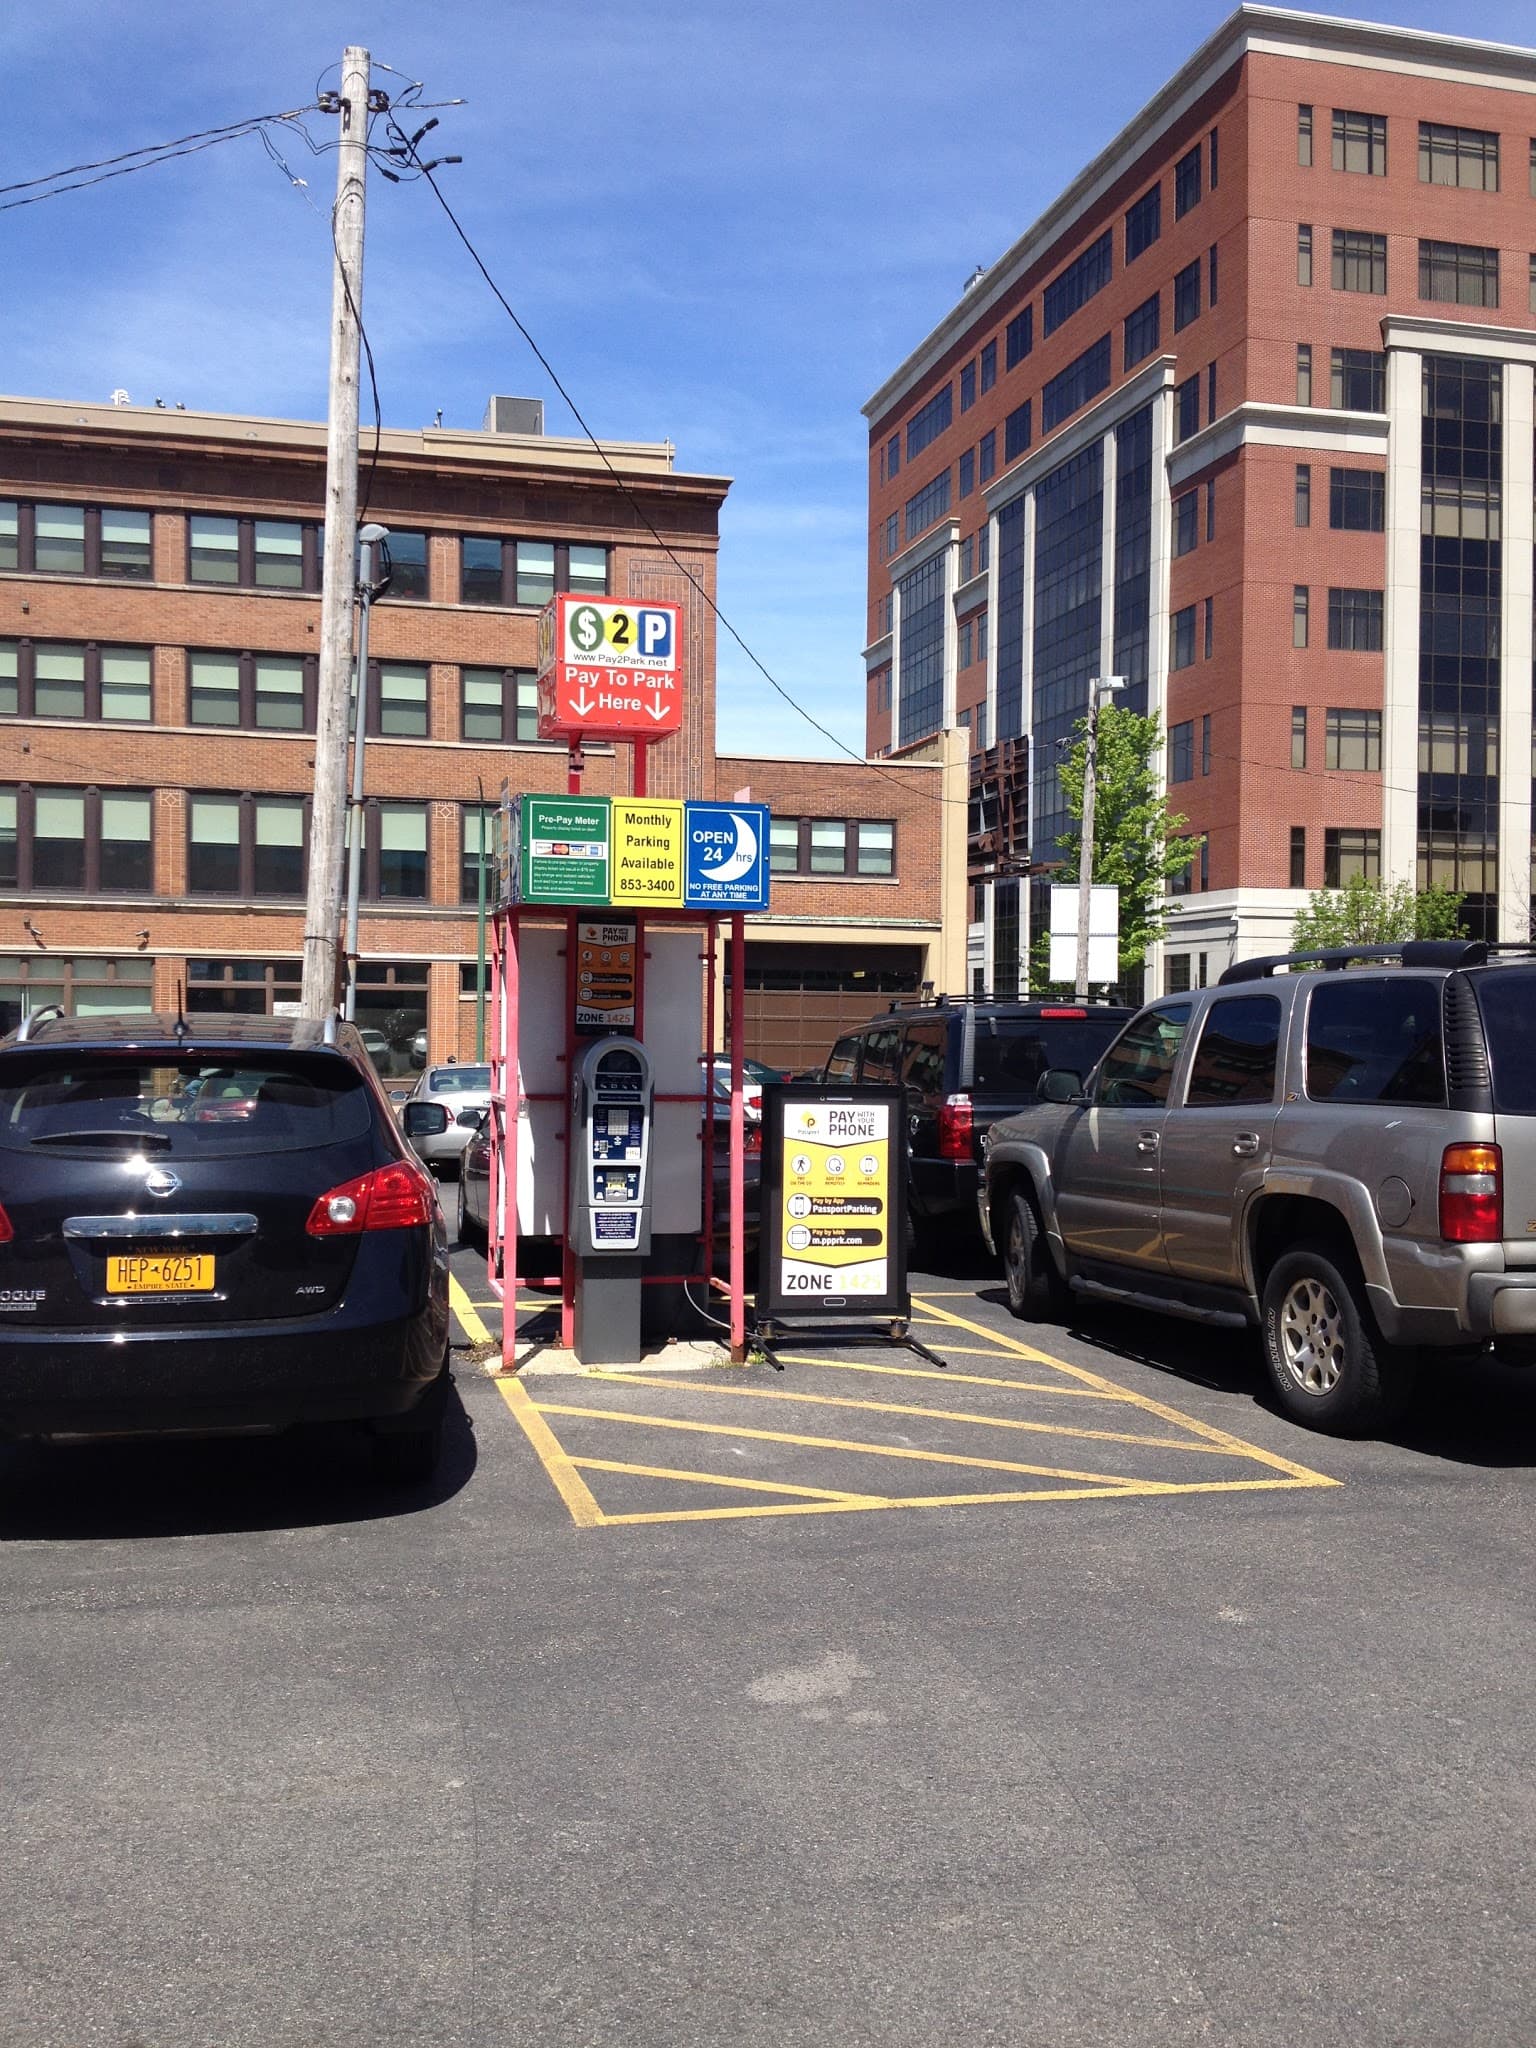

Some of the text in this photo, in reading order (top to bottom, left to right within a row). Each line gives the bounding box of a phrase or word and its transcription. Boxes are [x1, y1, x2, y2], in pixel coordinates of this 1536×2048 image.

[612, 613, 630, 645] 2
[644, 613, 667, 654] P
[565, 666, 675, 690] Pay To Park
[598, 692, 642, 711] Here
[538, 814, 600, 826] Pre-Pay Meter
[625, 813, 672, 829] Monthly
[626, 835, 670, 851] Parking
[692, 830, 734, 844] OPEN
[703, 846, 753, 863] 24 hrs
[620, 857, 675, 870] Available
[620, 878, 675, 892] 853-3400
[724, 884, 759, 892] PARKING
[700, 891, 748, 900] AT ANY TIME
[602, 927, 618, 935] PAY
[577, 1013, 604, 1023] ZONE
[829, 1110, 856, 1123] PAY
[828, 1124, 875, 1136] PHONE
[812, 1204, 878, 1215] PassportParking
[117, 1257, 202, 1283] HEP 6251
[786, 1274, 833, 1290] ZONE
[295, 1285, 326, 1295] AWD
